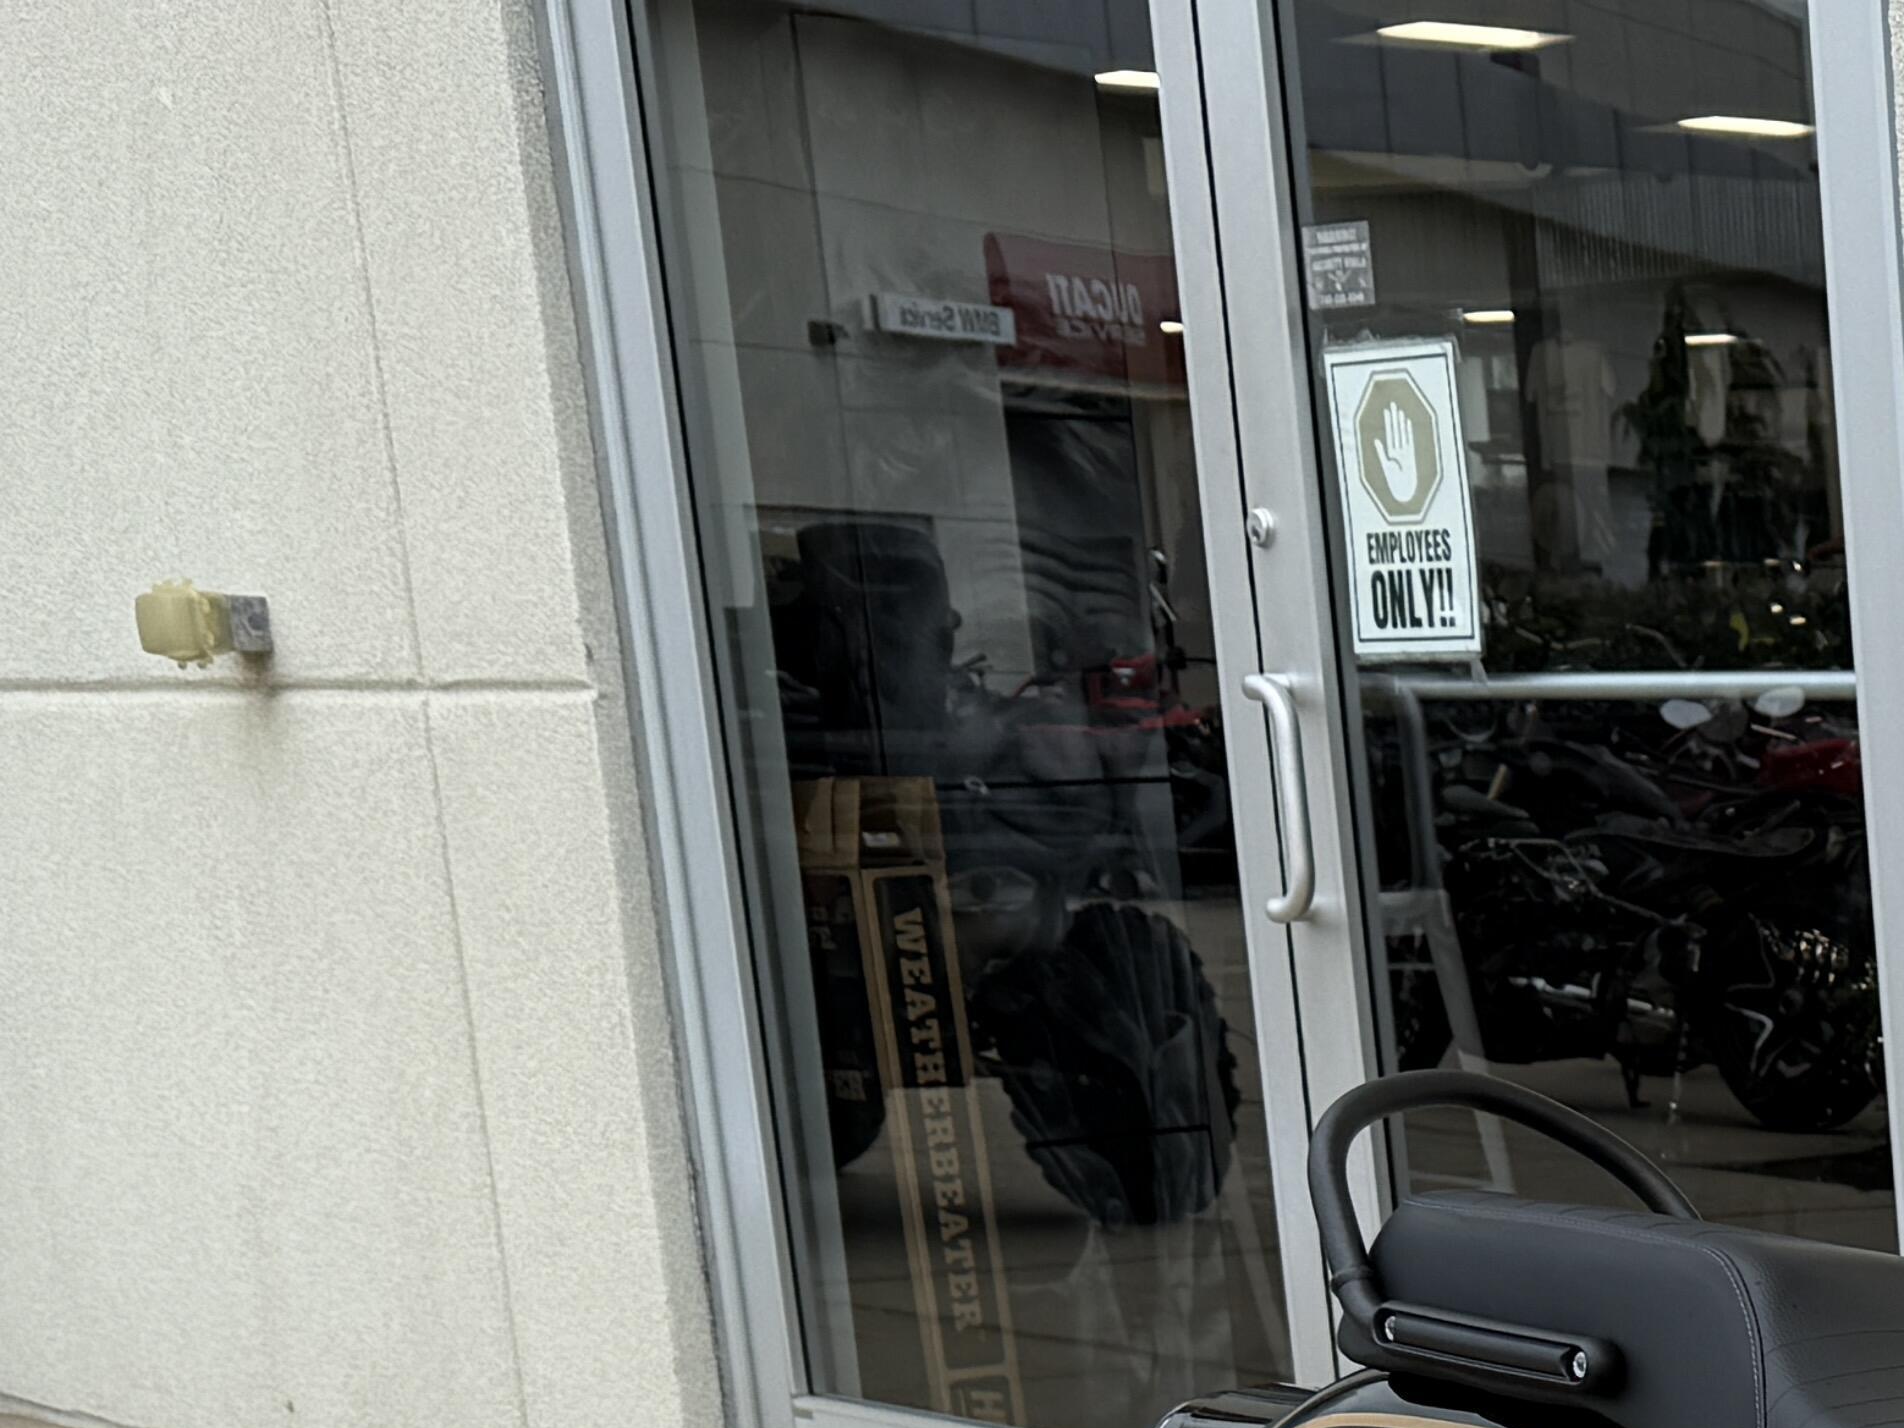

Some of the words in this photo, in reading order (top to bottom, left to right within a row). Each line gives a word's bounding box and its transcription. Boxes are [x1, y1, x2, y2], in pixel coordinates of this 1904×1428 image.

[1366, 528, 1452, 565] EMPLOYEES
[1371, 567, 1456, 629] ONLY!!
[893, 906, 983, 1332] WEATHERBEATER
